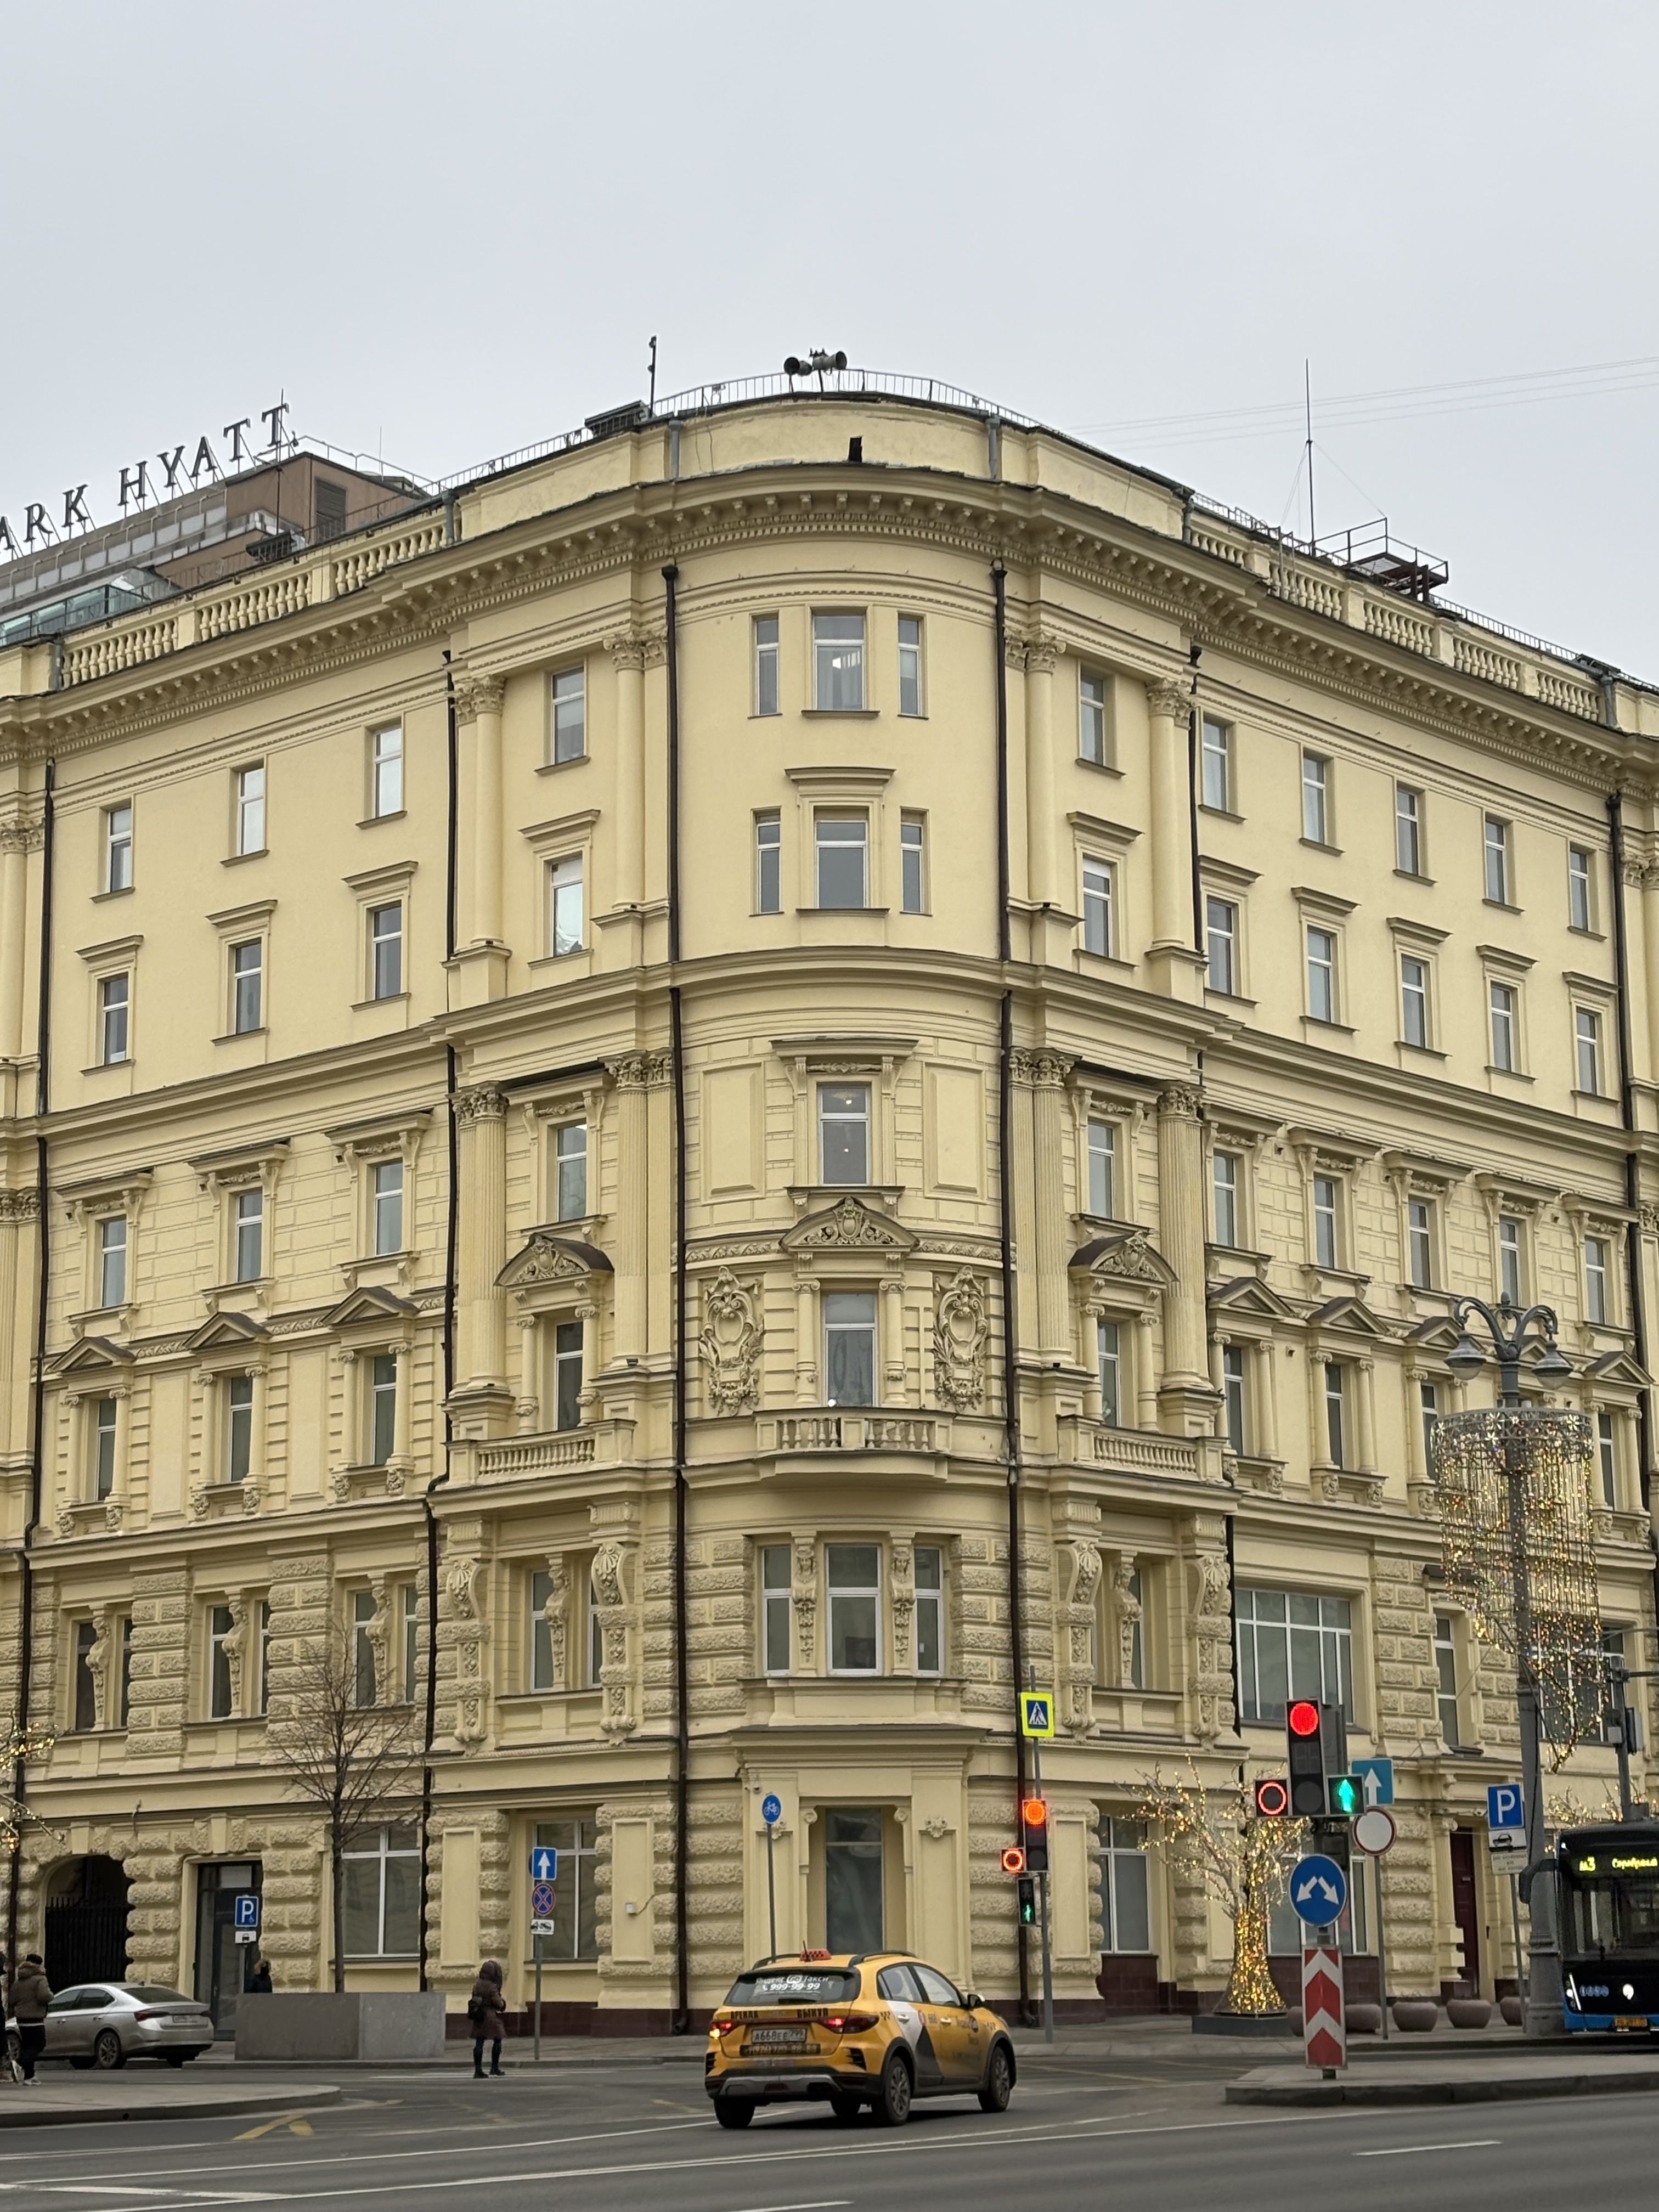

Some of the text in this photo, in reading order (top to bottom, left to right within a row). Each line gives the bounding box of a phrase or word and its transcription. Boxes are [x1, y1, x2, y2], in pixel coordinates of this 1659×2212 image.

[117, 403, 289, 506] HYATT
[1497, 1790, 1515, 1824] P
[241, 1900, 254, 1923] P
[770, 1983, 821, 1991] 999-99-99
